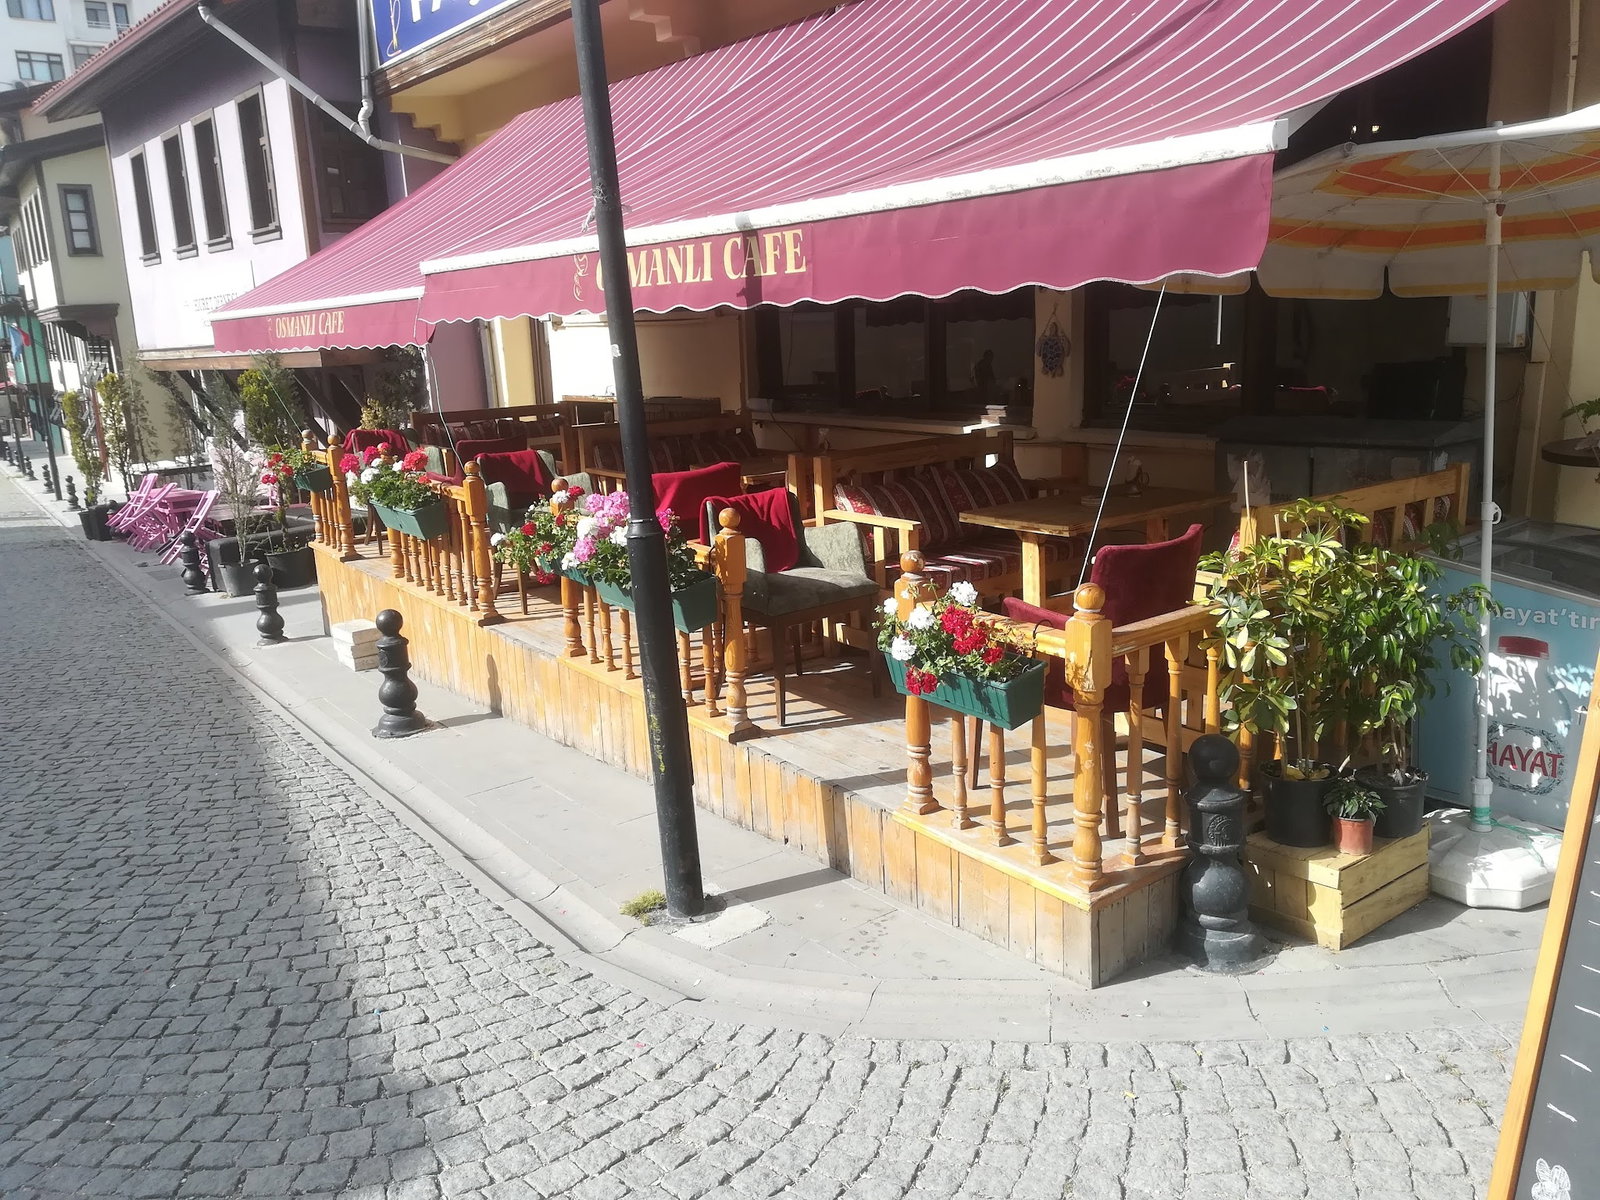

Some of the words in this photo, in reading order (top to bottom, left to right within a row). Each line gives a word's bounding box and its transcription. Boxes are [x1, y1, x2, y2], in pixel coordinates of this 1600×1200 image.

[596, 241, 713, 292] MANLI
[723, 229, 807, 280] CAFE
[275, 314, 316, 338] OSMANLI
[318, 311, 345, 335] CAFE
